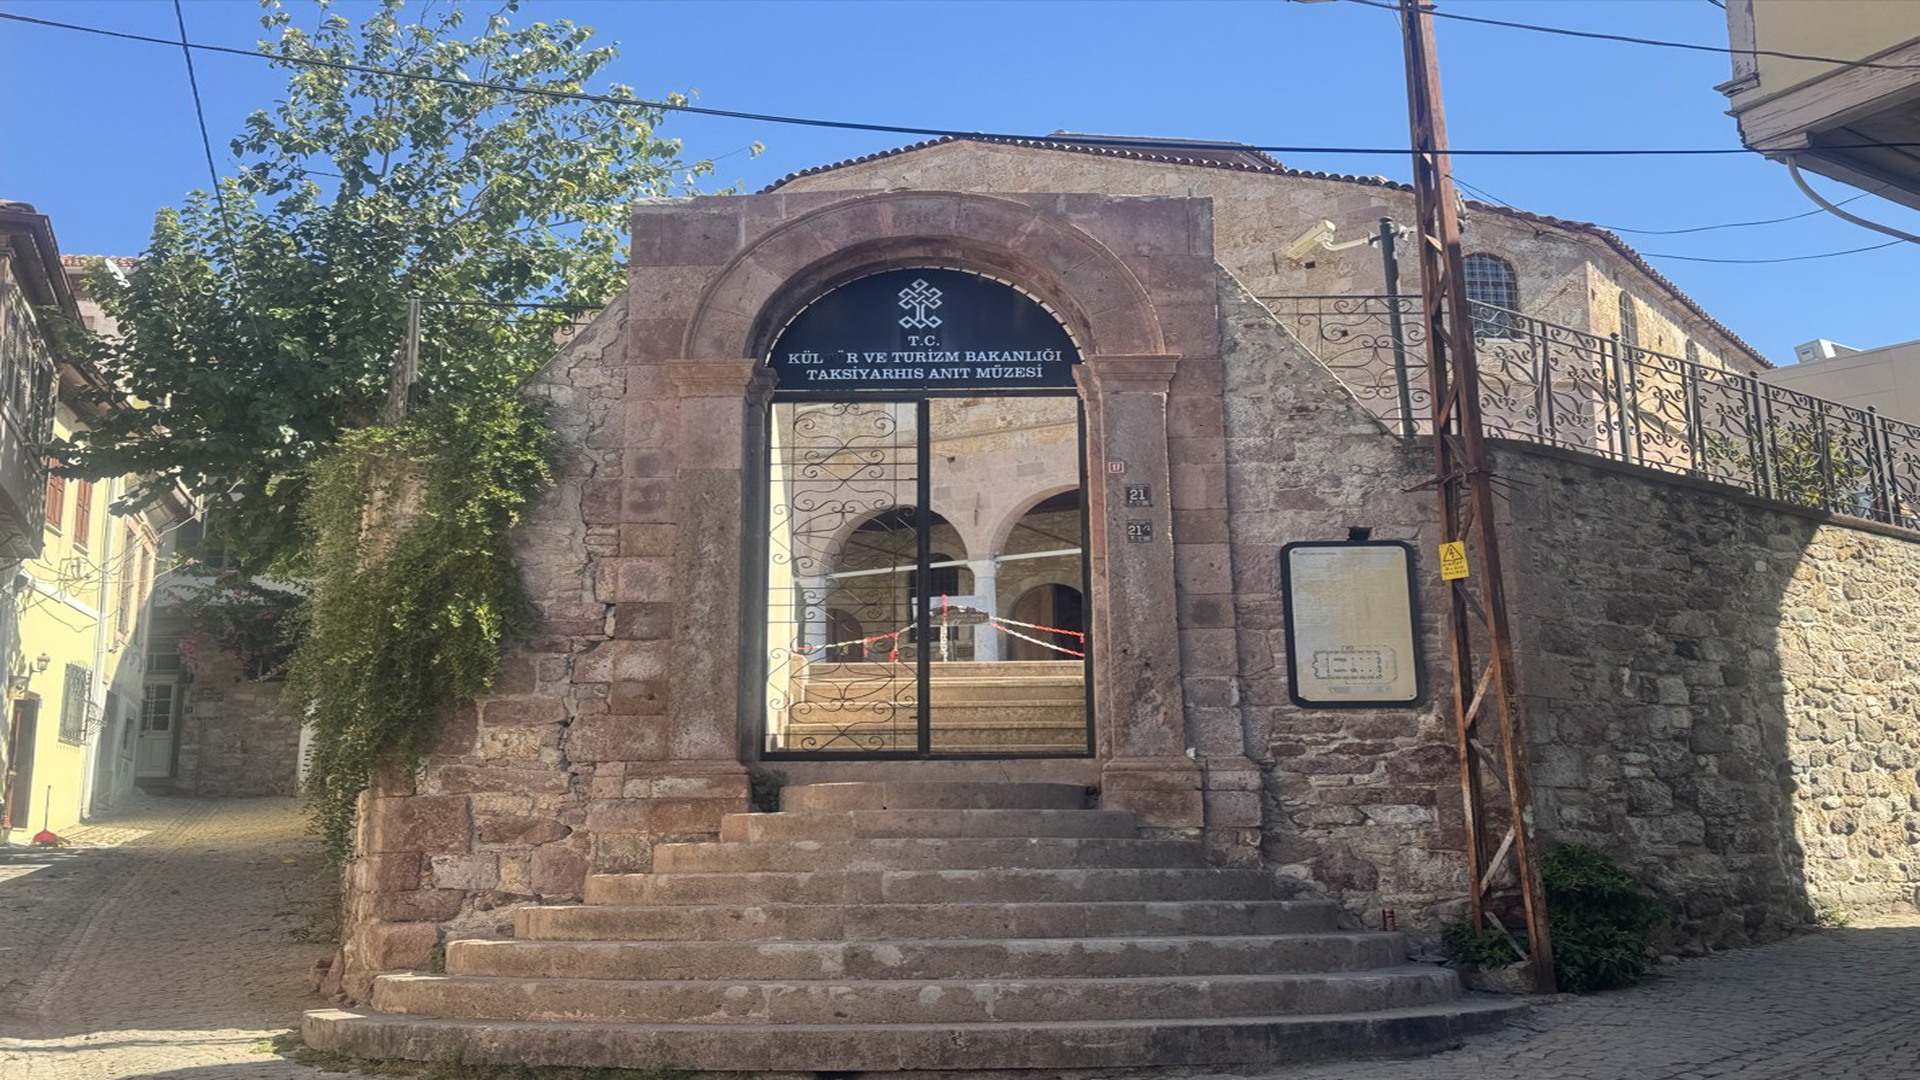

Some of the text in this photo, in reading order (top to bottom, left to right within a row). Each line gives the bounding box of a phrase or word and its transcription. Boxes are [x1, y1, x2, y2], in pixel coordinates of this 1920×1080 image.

[907, 335, 940, 346] T.C.
[787, 348, 1062, 364] KÜLR VE TURİZM BAKANLIĞI
[806, 364, 1043, 380] TAKSİYARHIS ANIT MÜZESİ
[1129, 489, 1145, 500] 21
